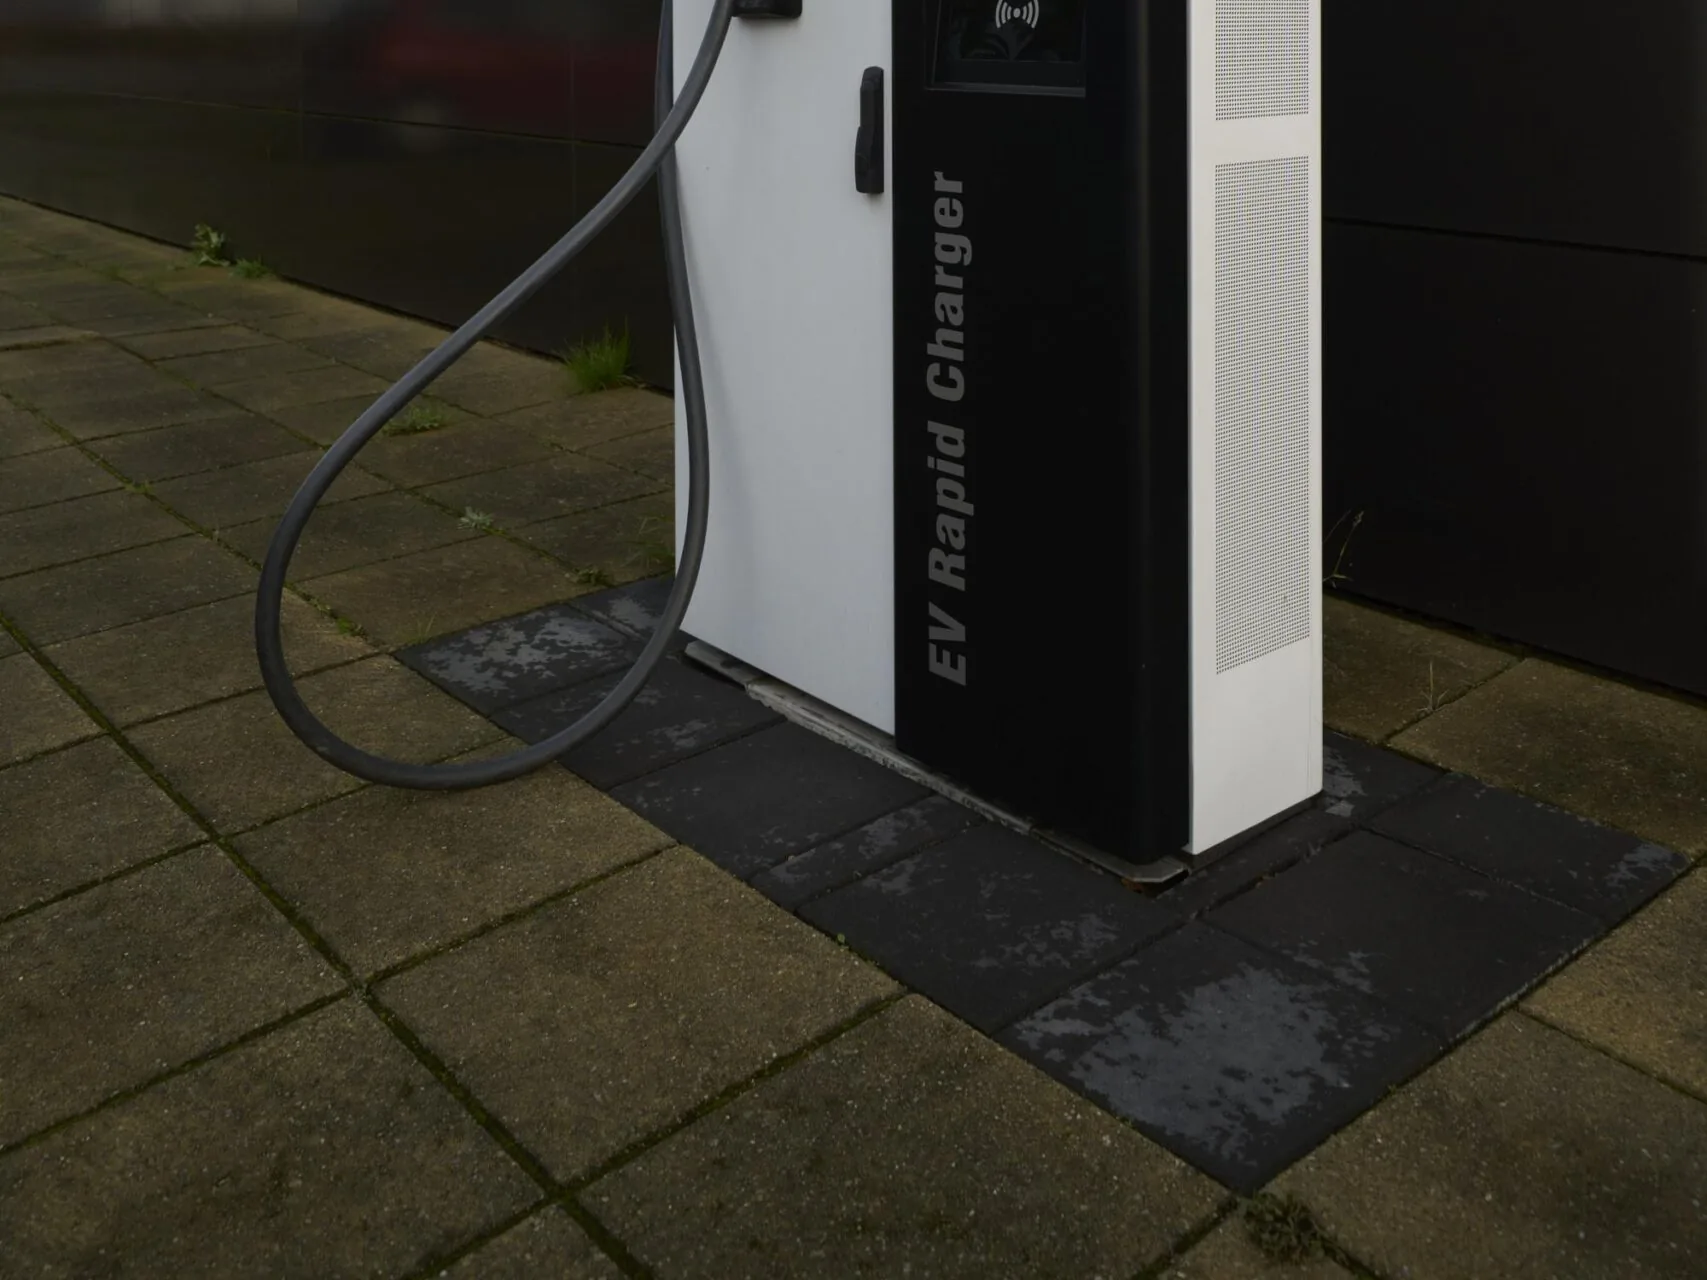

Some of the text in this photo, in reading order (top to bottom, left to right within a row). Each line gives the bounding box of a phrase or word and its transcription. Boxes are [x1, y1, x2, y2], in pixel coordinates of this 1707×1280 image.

[926, 171, 974, 686] EV Rapid Charger
